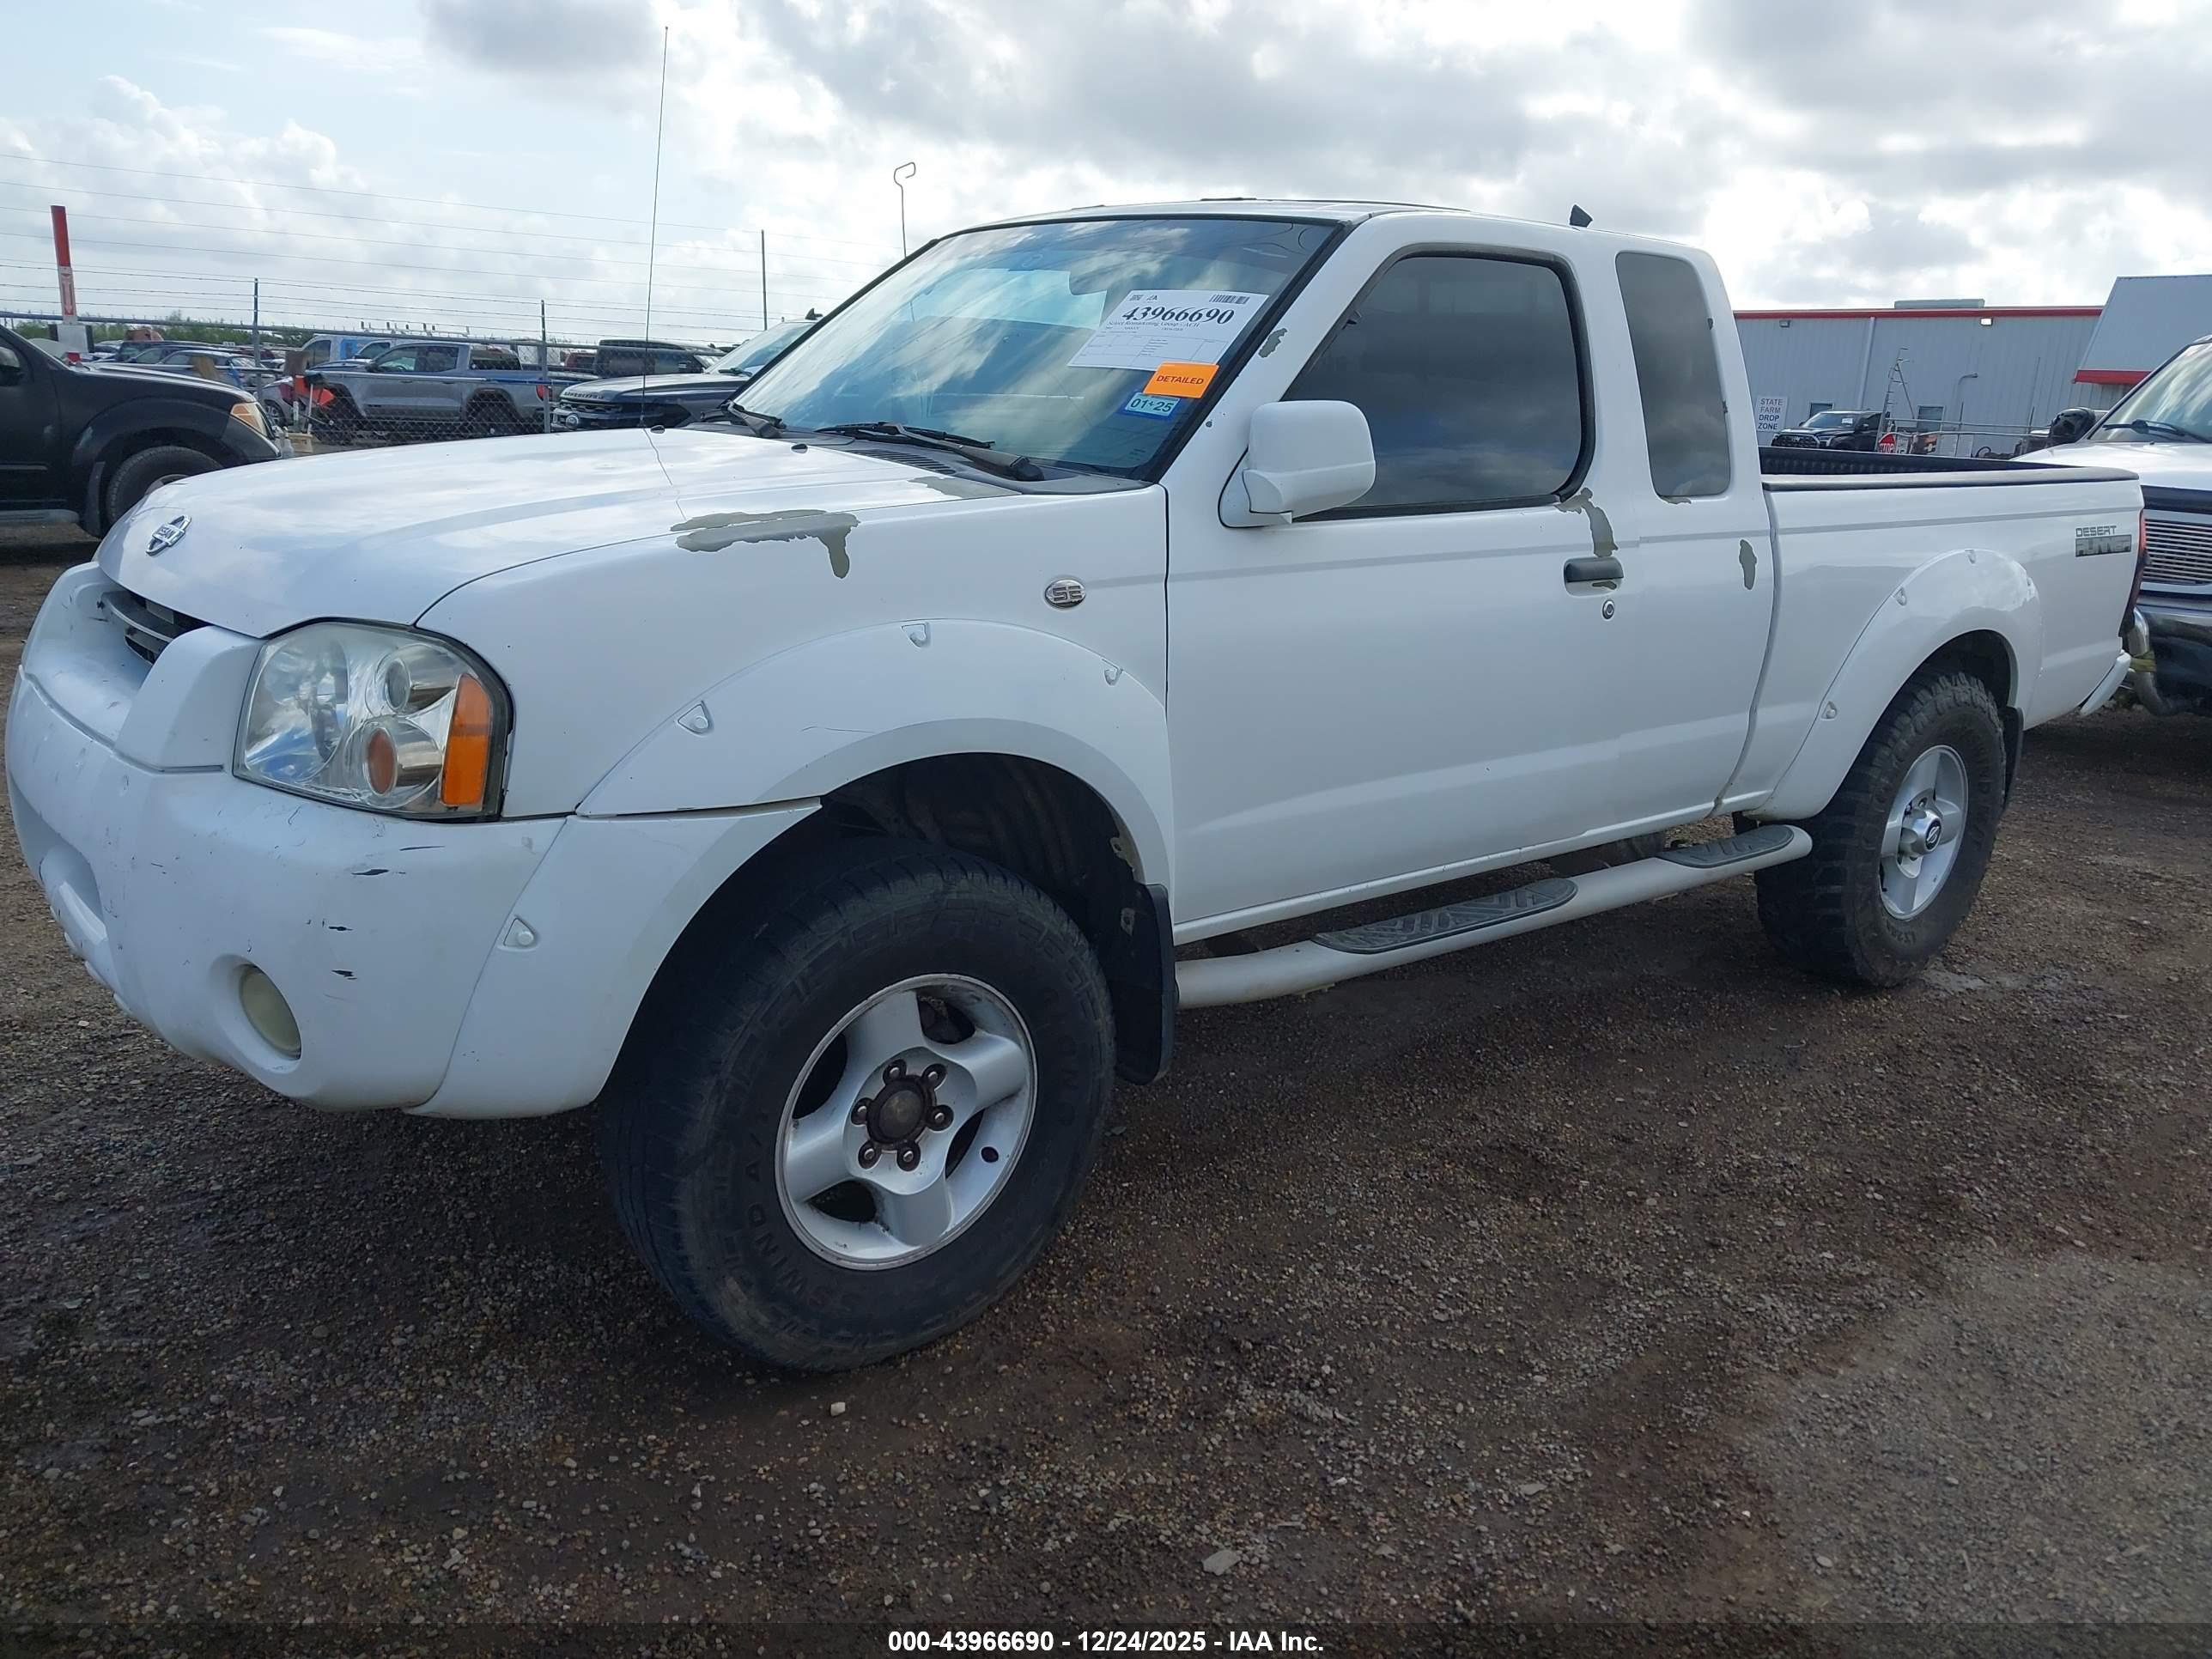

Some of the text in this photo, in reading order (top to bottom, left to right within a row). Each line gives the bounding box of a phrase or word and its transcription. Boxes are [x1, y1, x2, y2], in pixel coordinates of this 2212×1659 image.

[1122, 305, 1235, 325] 43966690
[1156, 374, 1205, 386] DETAILED
[1760, 398, 1784, 406] STATE
[2075, 526, 2117, 538] DESERT
[1052, 585, 1083, 602] SE
